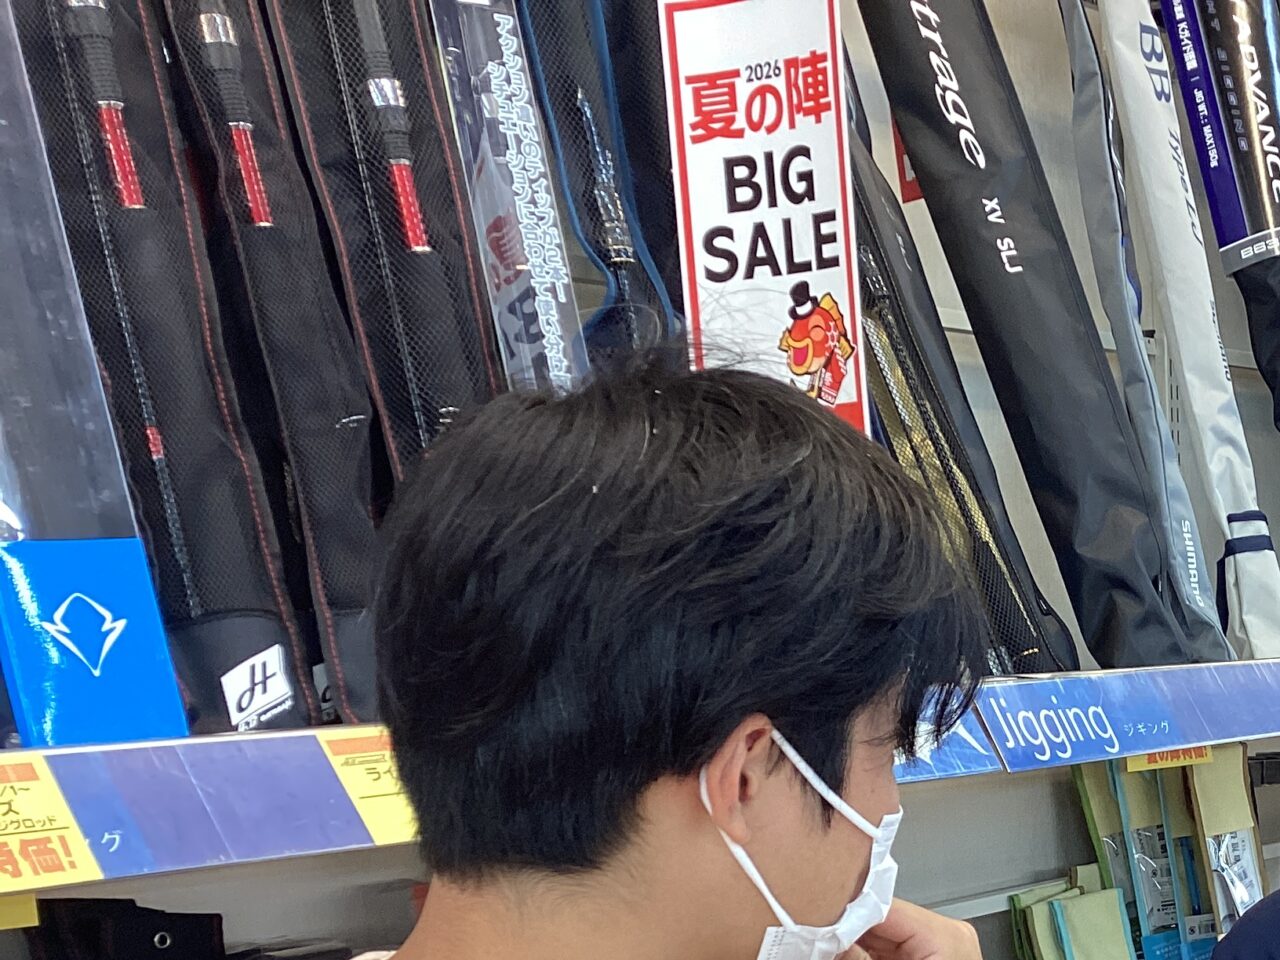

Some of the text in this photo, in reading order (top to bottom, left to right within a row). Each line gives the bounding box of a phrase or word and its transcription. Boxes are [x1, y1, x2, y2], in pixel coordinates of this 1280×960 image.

[684, 49, 832, 144] 夏の陣
[745, 60, 782, 83] 2026
[1139, 21, 1171, 103] BB
[722, 144, 816, 214] BIG
[702, 208, 841, 283] SALE
[982, 197, 1005, 224] XV
[996, 236, 1023, 273] SLJ
[1181, 519, 1204, 608] SHIMANO
[990, 695, 1170, 762] Jigging ジギング
